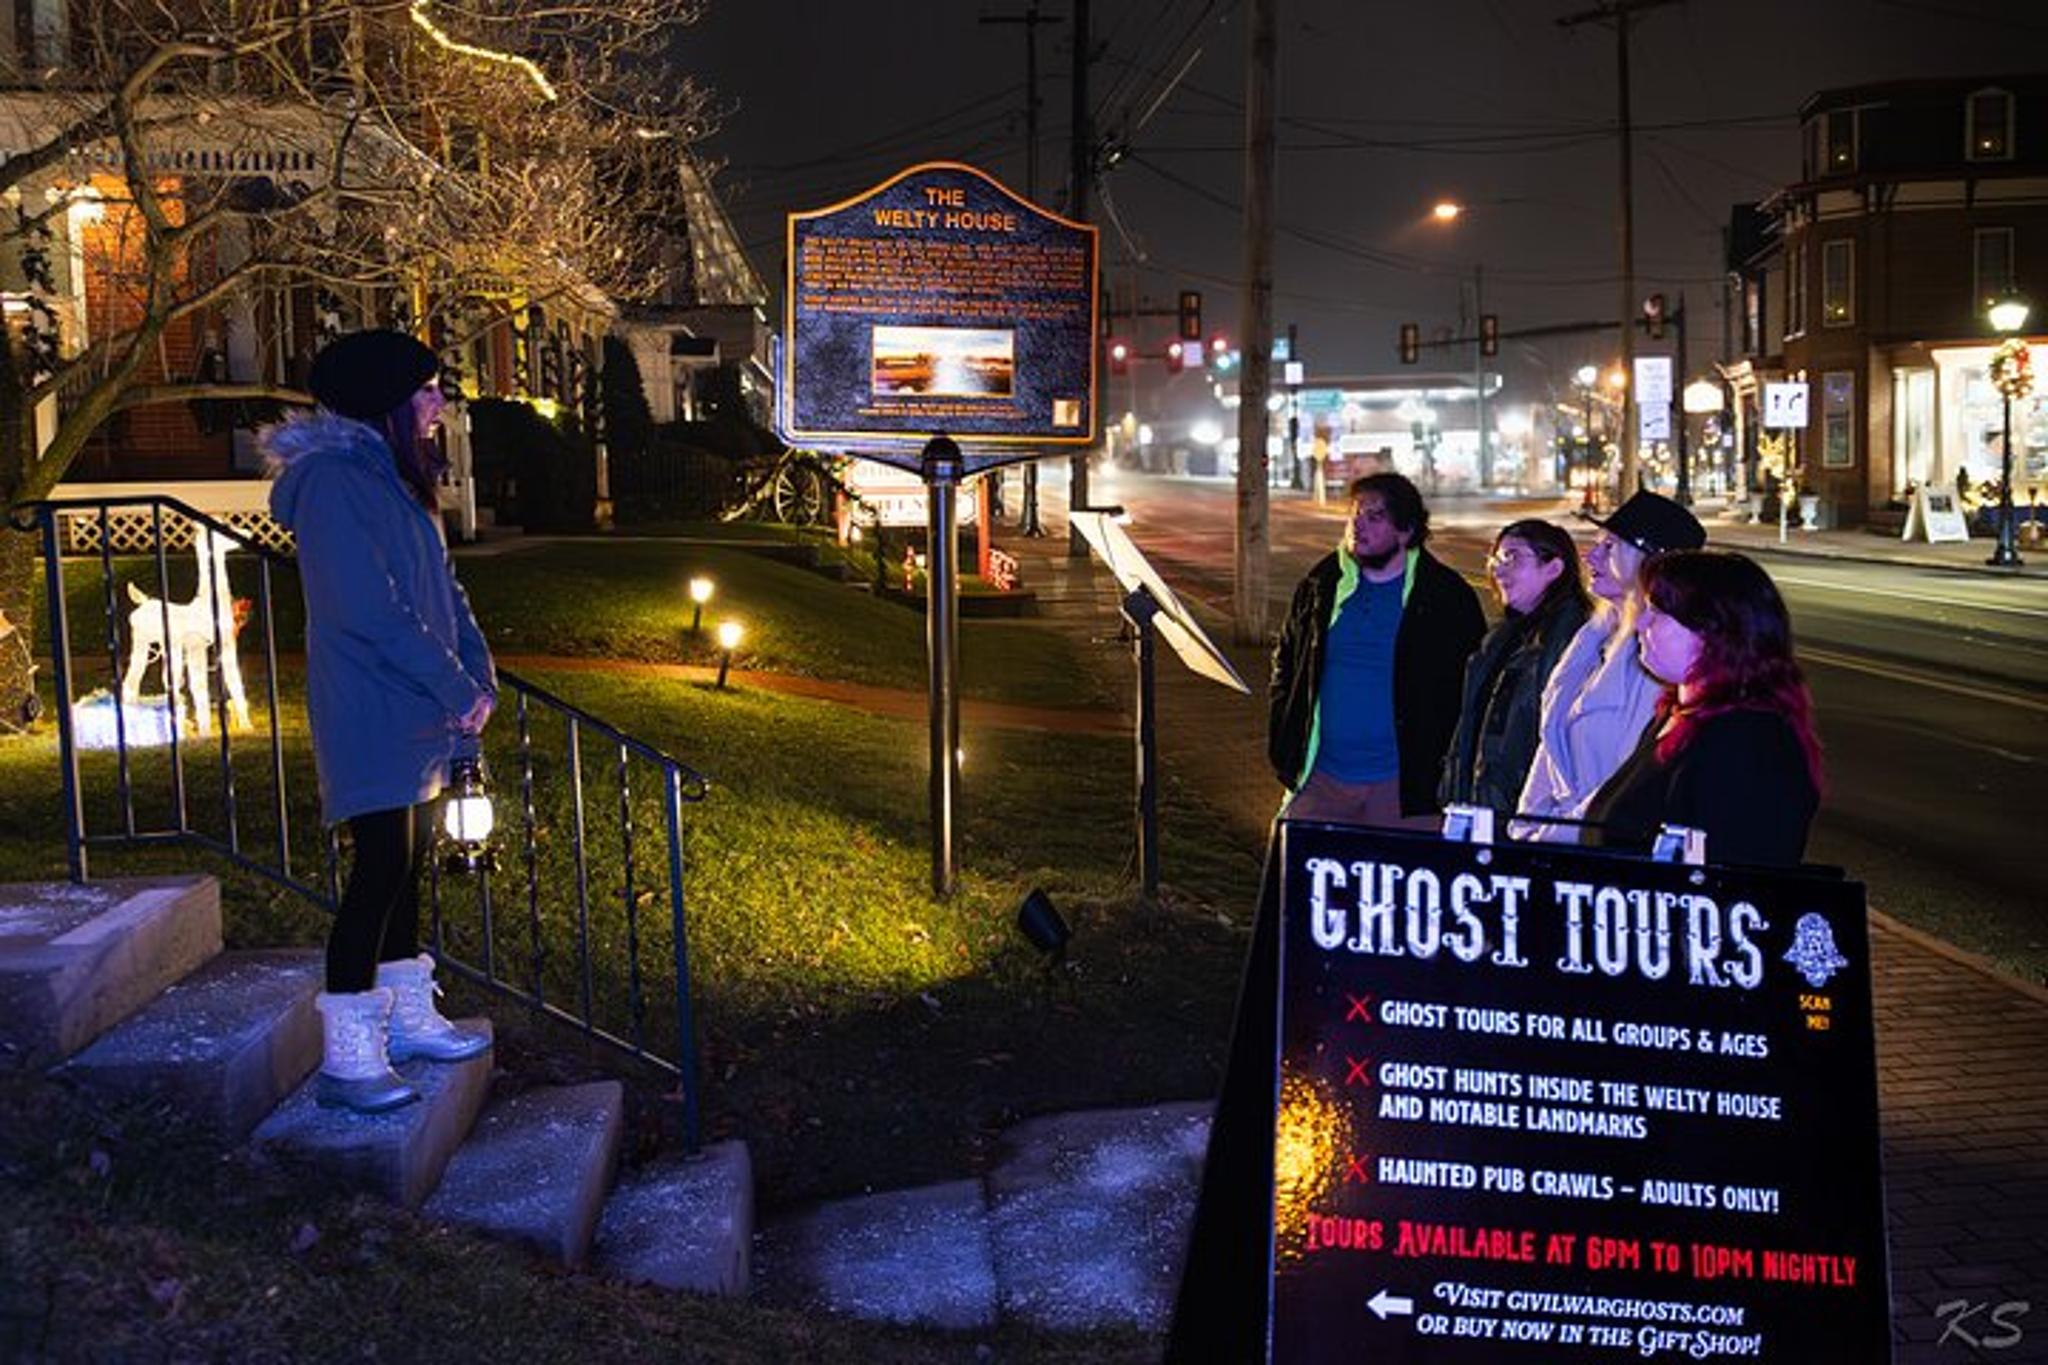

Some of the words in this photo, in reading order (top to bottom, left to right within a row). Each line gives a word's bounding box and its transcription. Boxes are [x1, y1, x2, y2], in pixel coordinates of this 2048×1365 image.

[874, 209, 939, 229] WELTY
[945, 212, 1017, 231] HOUSE
[926, 187, 965, 206] THE
[1306, 858, 1531, 967] GHOST
[1553, 881, 1769, 989] TOURS
[1381, 1001, 1448, 1028] GHOST
[1454, 1006, 1520, 1034] TOURS
[1527, 1014, 1566, 1039] FOR
[1572, 1018, 1607, 1043] ALL
[1613, 1022, 1691, 1051] GROUPS
[1698, 1030, 1714, 1053] &
[1720, 1032, 1769, 1058] AGES
[1379, 1062, 1448, 1090] GHOST
[1454, 1069, 1523, 1096] HUNTS
[1529, 1075, 1594, 1103] INSIDE
[1600, 1082, 1639, 1107] THE
[1644, 1086, 1711, 1114] WELTY
[1717, 1092, 1782, 1120] HOUSE
[1379, 1094, 1424, 1119] AND
[1430, 1098, 1520, 1127] NOTABLE
[1527, 1107, 1648, 1139] LANDMARKS
[1379, 1157, 1477, 1189] HAUNTED
[1483, 1166, 1526, 1192] PUB
[1531, 1171, 1614, 1199] CRAWLS
[1641, 1179, 1717, 1208] ADULTS
[1722, 1186, 1780, 1214] ONLY!
[1304, 1213, 1384, 1250] TOURS
[1393, 1221, 1536, 1262] AVAILABLE
[1545, 1234, 1577, 1264] AT
[1587, 1236, 1641, 1270] 6PM
[1649, 1243, 1681, 1272] TO
[1692, 1243, 1753, 1279] 10PM
[1763, 1251, 1857, 1286] NIGHTLY
[1433, 1282, 1504, 1310] VISIT
[1506, 1291, 1745, 1326] CIVILWARGHOSTS.COM
[1416, 1315, 1449, 1335] OR
[1453, 1319, 1498, 1338] BUY
[1501, 1320, 1555, 1341] NOW
[1558, 1325, 1585, 1343] IN
[1589, 1326, 1634, 1347] THE
